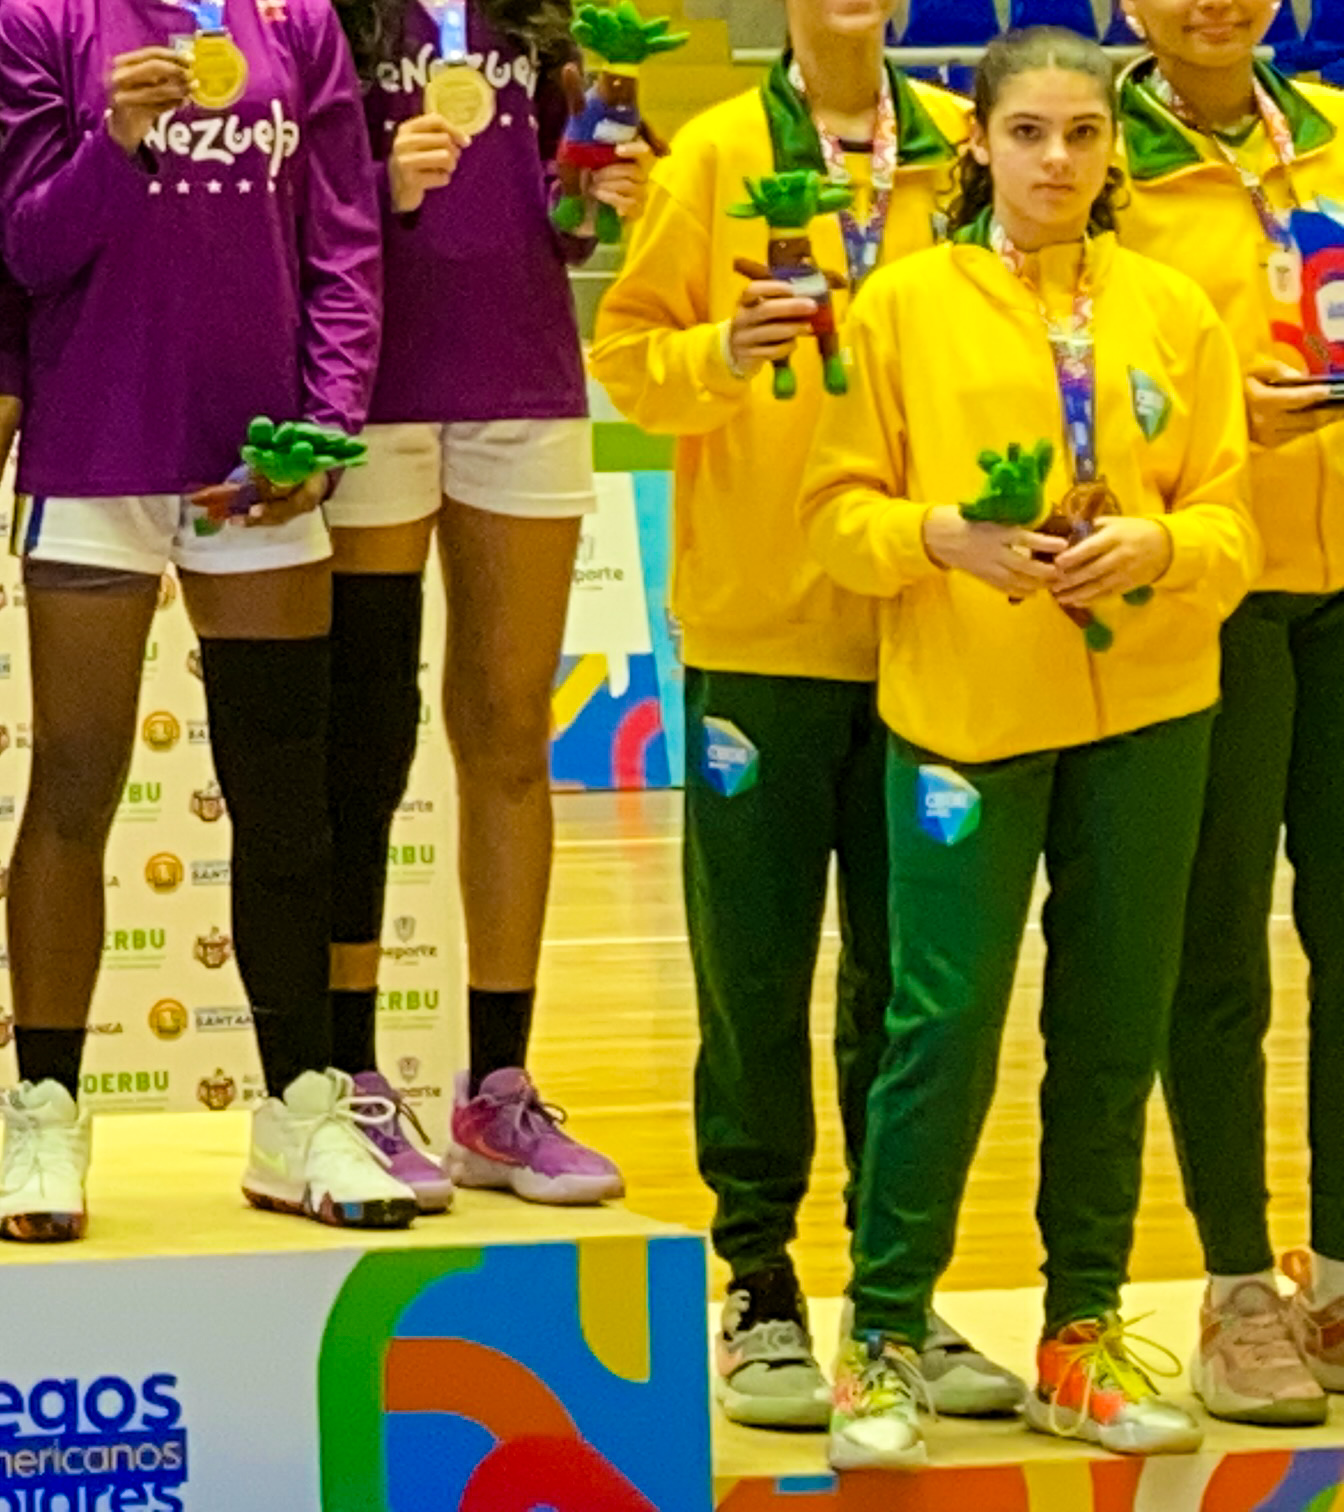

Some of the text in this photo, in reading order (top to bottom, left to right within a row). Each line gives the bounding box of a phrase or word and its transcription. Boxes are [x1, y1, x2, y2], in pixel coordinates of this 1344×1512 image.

[574, 563, 624, 585] porte
[378, 990, 439, 1011] ERBU
[84, 1071, 169, 1094] DERBU
